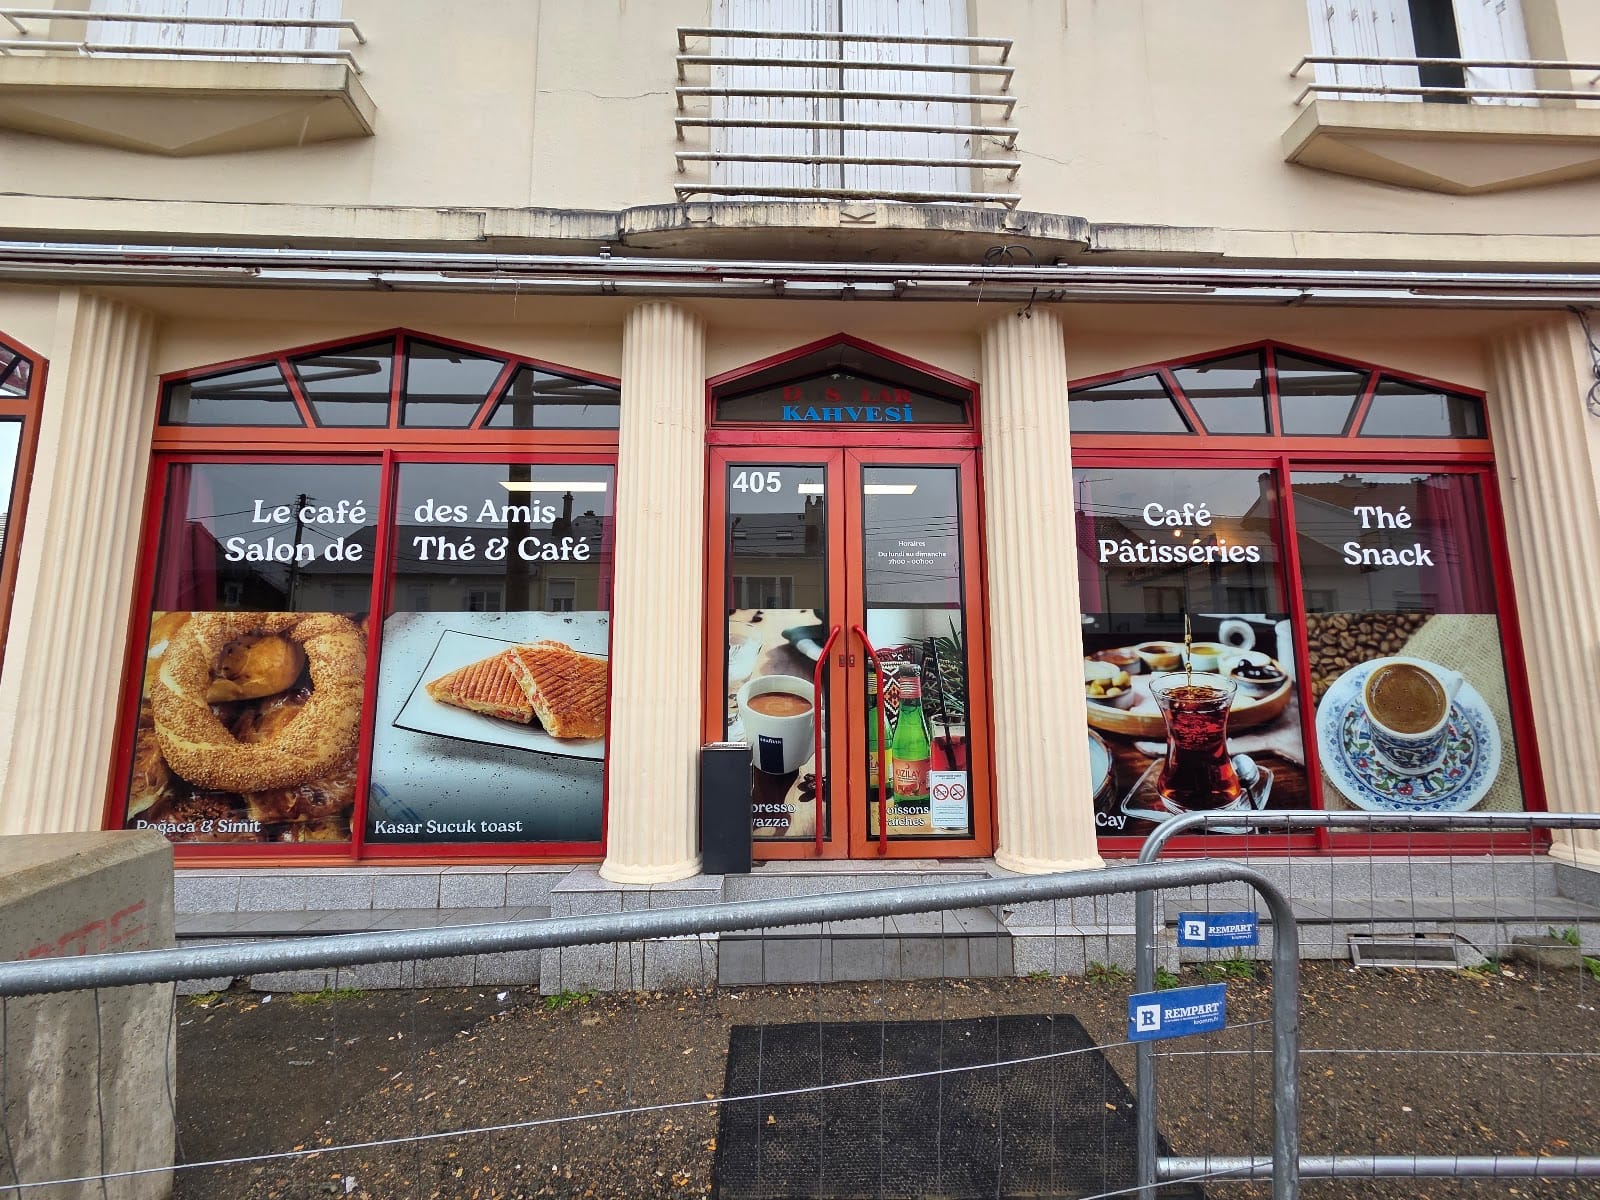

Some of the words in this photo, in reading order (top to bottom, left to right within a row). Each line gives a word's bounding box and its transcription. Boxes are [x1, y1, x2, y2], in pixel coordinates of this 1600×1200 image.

[782, 404, 913, 423] KAHVESİ
[732, 471, 782, 493] 405
[252, 499, 291, 524] Le
[298, 499, 367, 524] café
[414, 498, 468, 523] des
[475, 499, 556, 524] Amis
[1142, 502, 1212, 527] Café
[1353, 505, 1412, 529] Thé
[225, 536, 316, 562] Salon
[324, 536, 363, 562] de
[412, 535, 476, 561] Thé
[484, 536, 509, 561] &
[518, 535, 591, 561] Café
[1098, 538, 1261, 563] Pâtisséries
[1343, 541, 1435, 567] Snack
[886, 803, 929, 814] oissons
[200, 819, 214, 833] &
[217, 819, 262, 833] Simit
[374, 819, 423, 834] Kasar
[427, 819, 477, 834] Sucuk
[480, 819, 523, 834] toast
[1096, 812, 1127, 829] Cay
[1208, 923, 1253, 934] REMPART
[1141, 1009, 1156, 1027] R
[1164, 1002, 1220, 1020] REMPART
